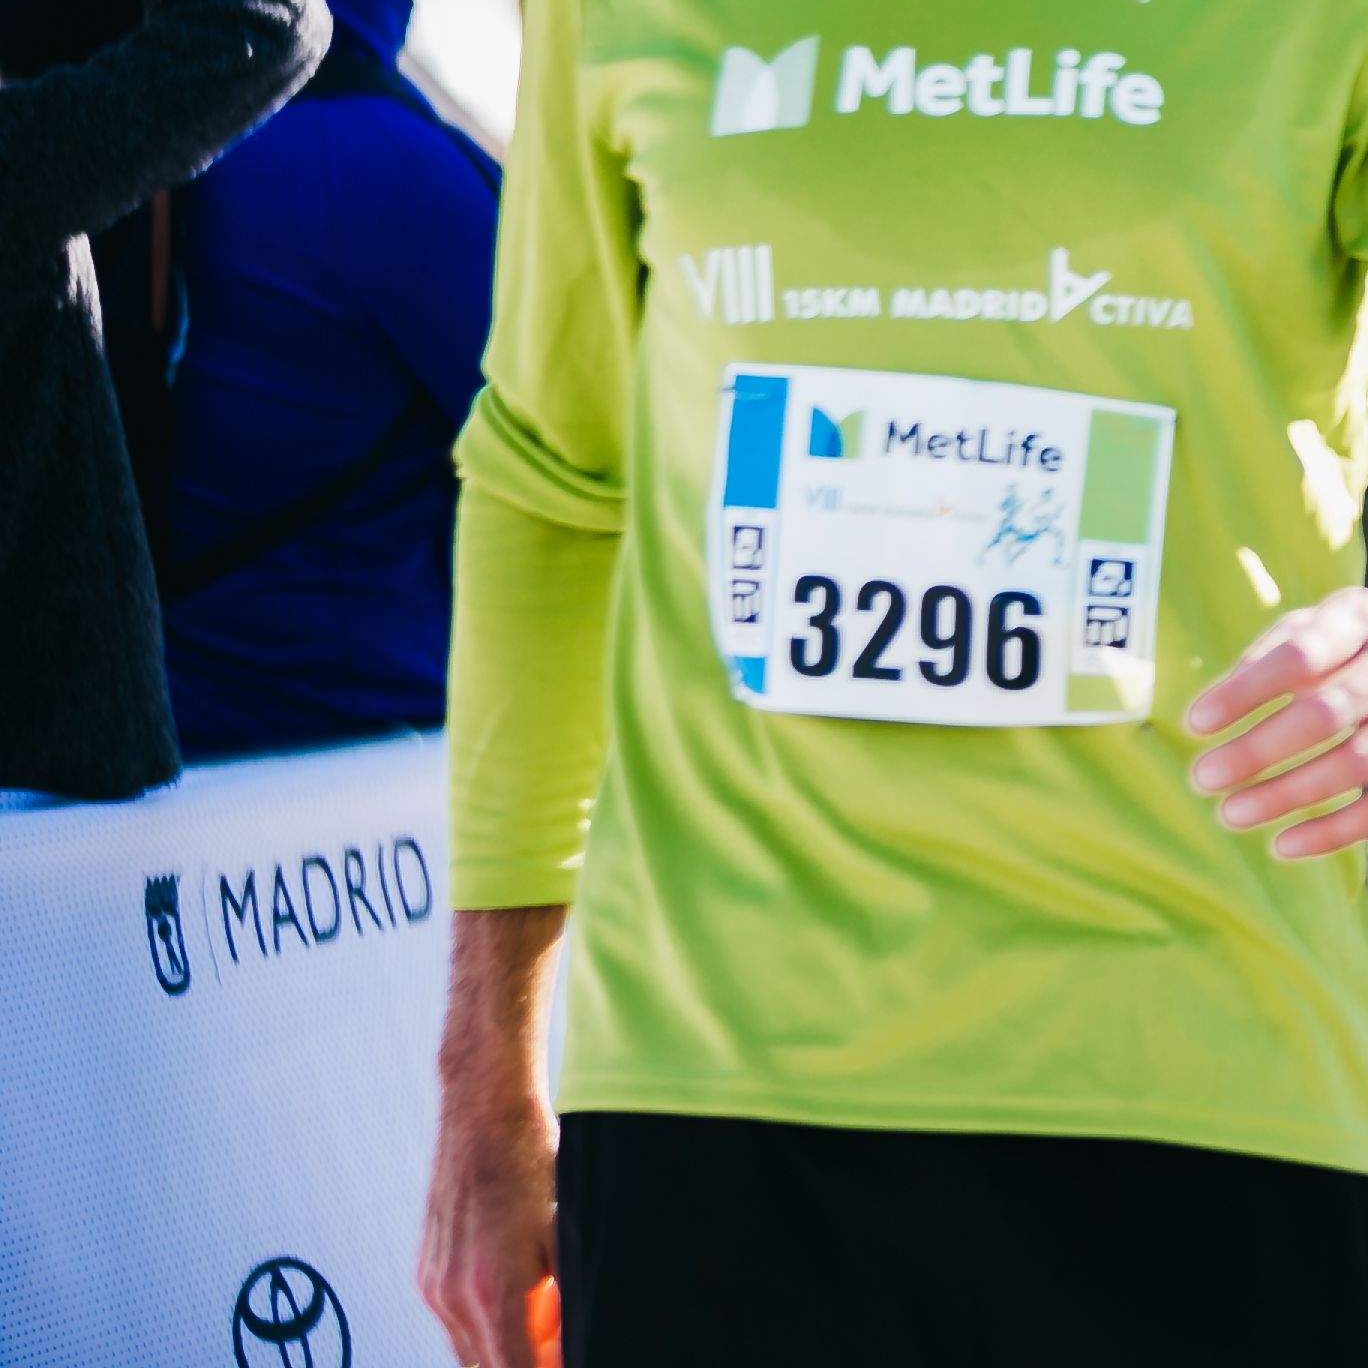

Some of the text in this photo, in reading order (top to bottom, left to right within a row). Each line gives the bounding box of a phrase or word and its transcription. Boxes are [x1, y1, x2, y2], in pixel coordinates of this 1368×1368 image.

[836, 45, 1164, 125] MetLife
[679, 243, 773, 324] VIII
[782, 287, 880, 319] 15KM
[884, 421, 1065, 473] MetLife
[790, 574, 1043, 691] 3296
[218, 836, 433, 965] MADRID
